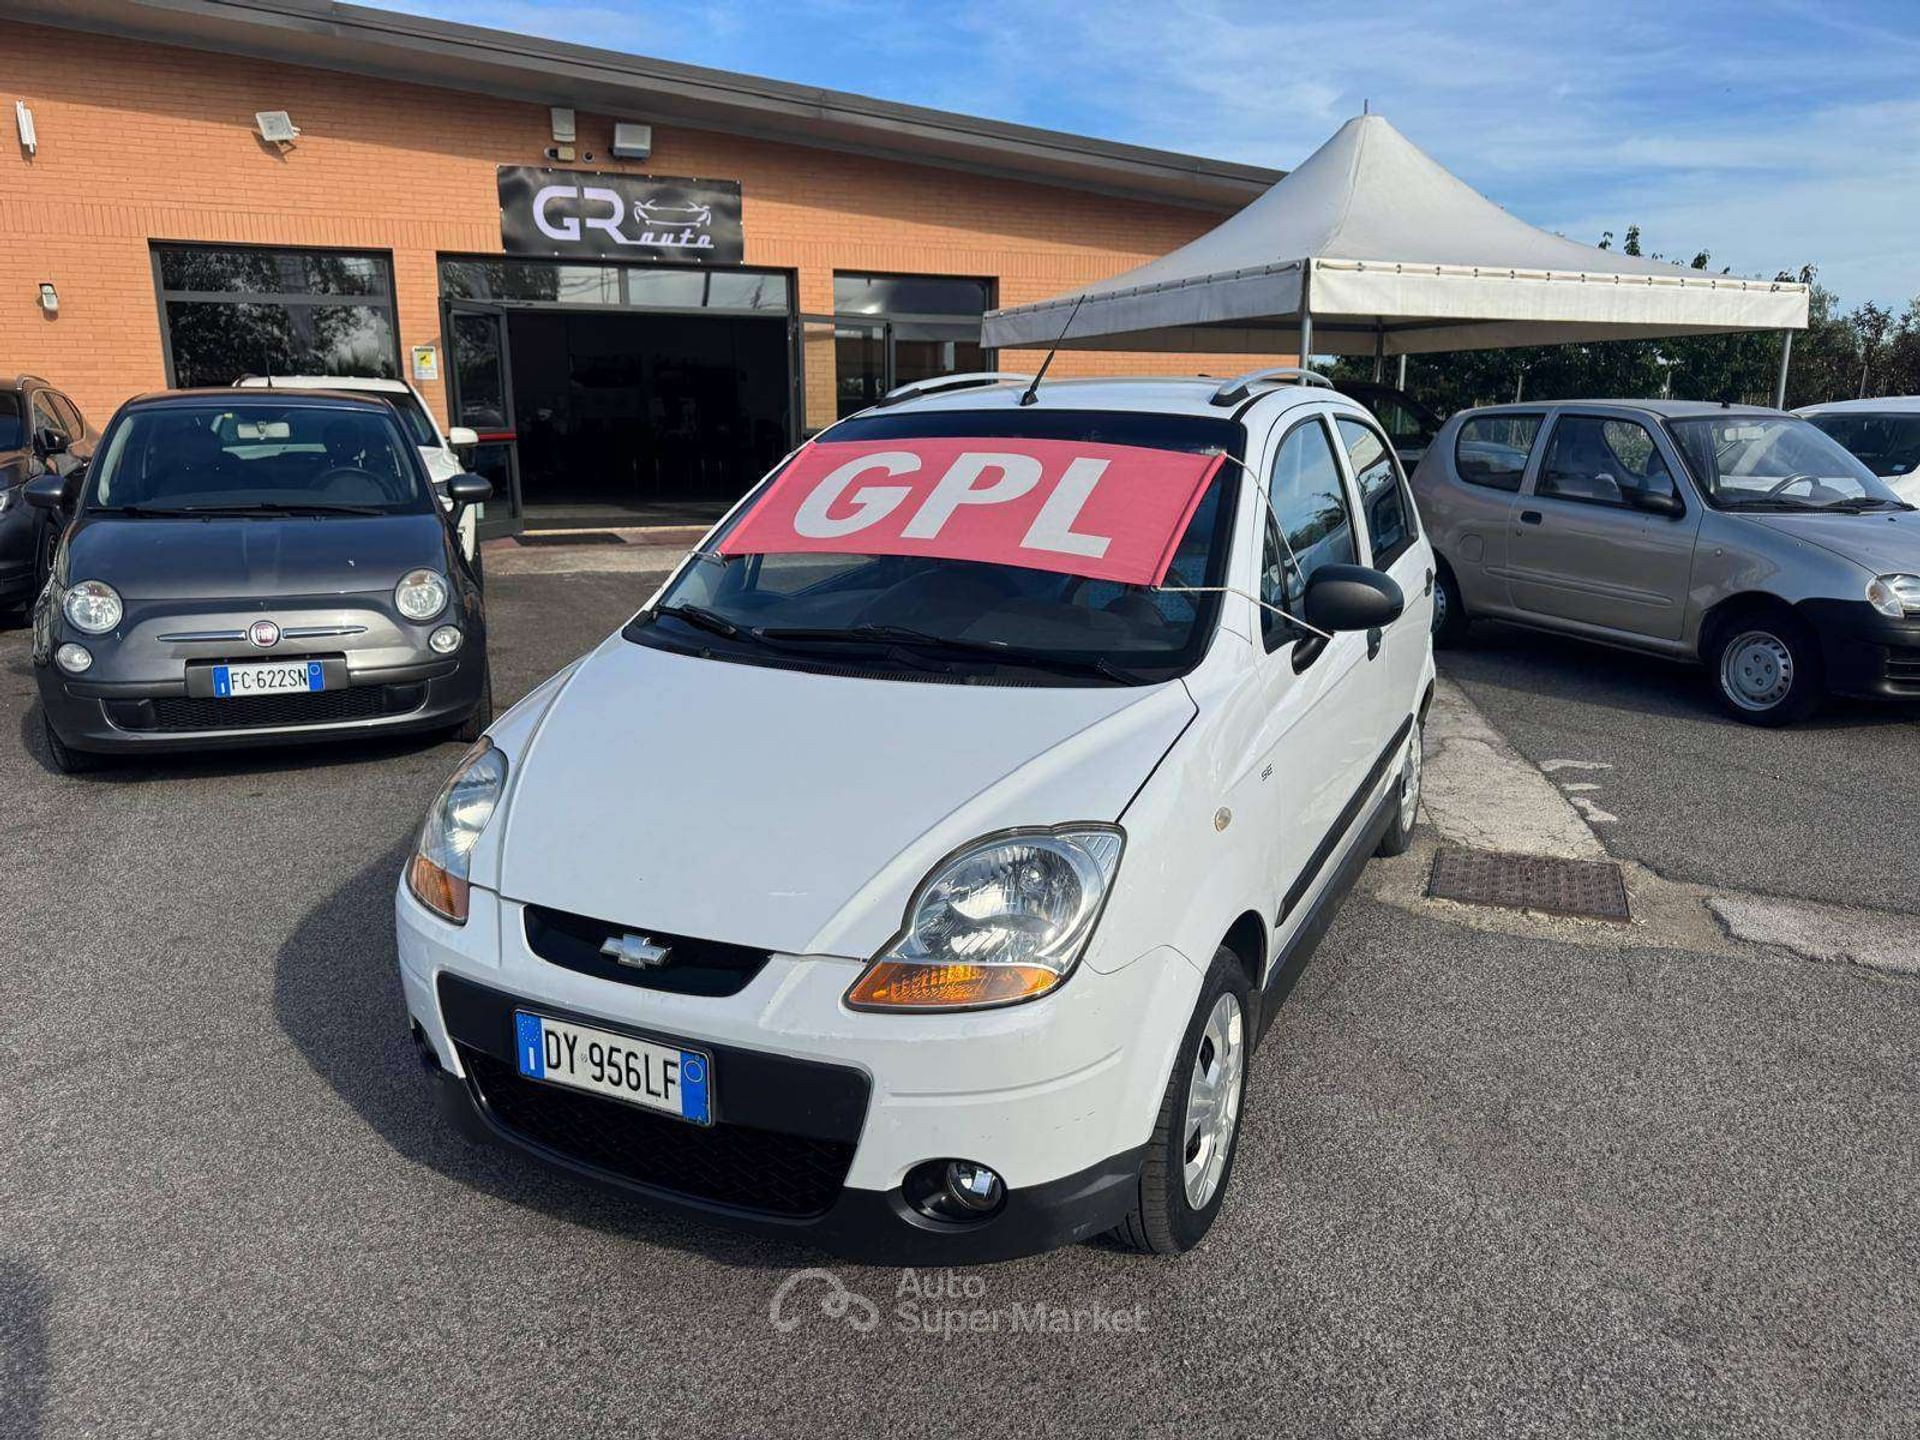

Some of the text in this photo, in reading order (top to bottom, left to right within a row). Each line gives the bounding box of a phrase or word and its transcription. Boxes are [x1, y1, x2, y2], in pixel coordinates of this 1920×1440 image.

[533, 185, 632, 244] GR
[639, 228, 713, 248] auto
[793, 451, 1113, 559] GPL
[230, 671, 251, 692] FC
[256, 668, 308, 689] 622SN
[545, 1030, 578, 1074] DY
[589, 1042, 680, 1100] 956LF
